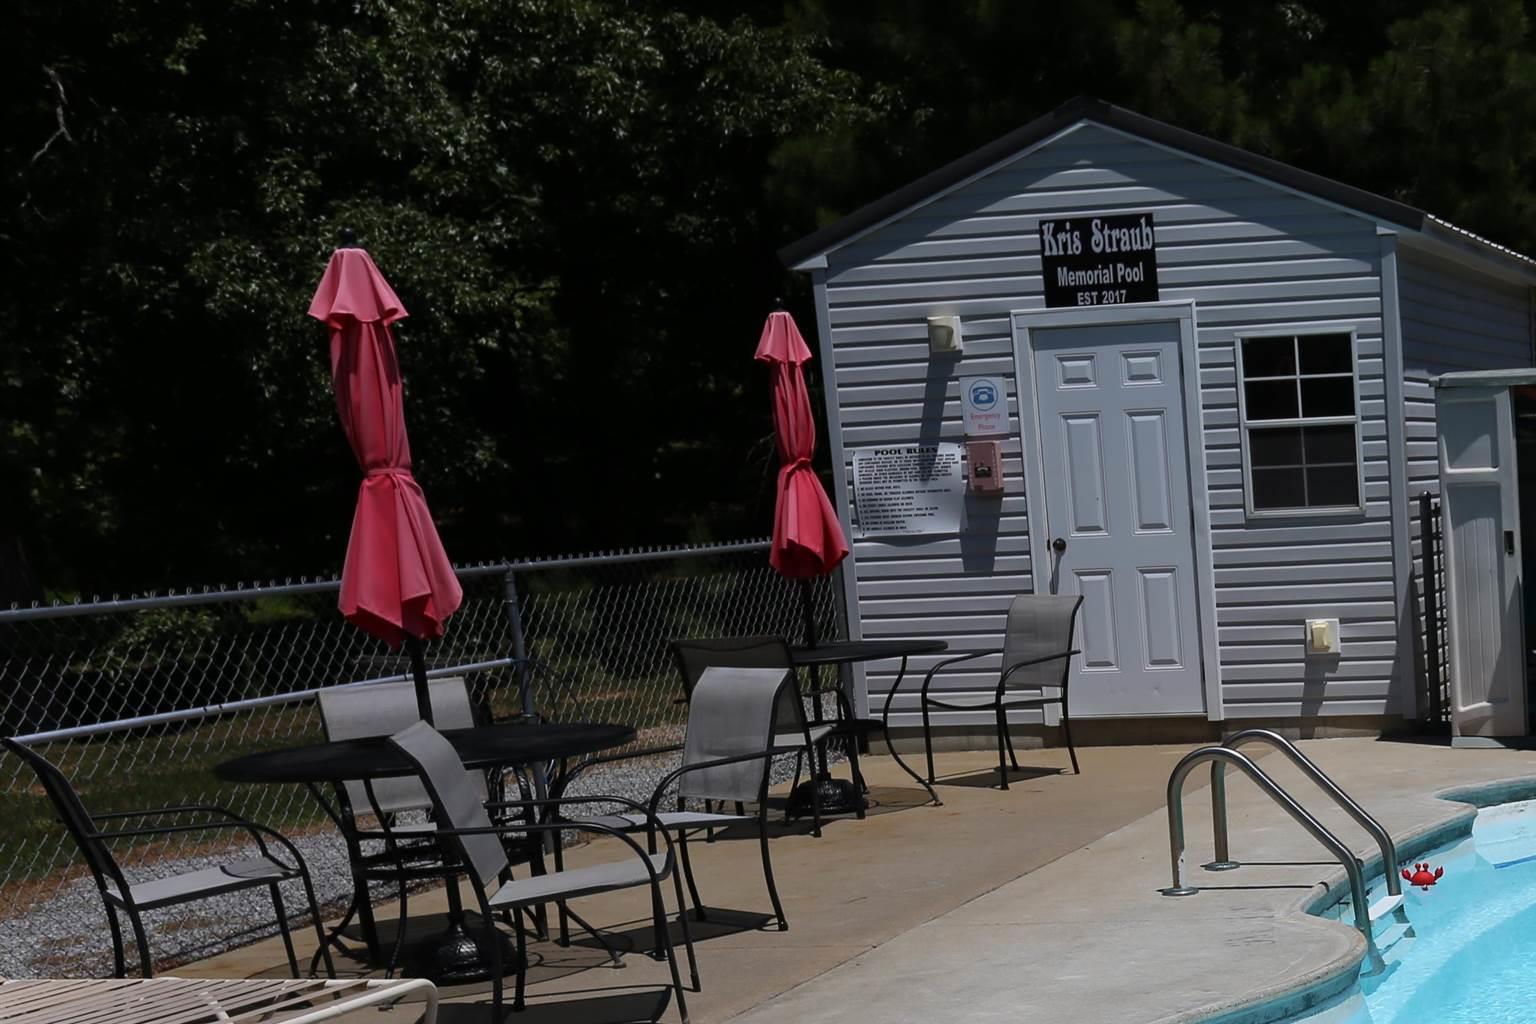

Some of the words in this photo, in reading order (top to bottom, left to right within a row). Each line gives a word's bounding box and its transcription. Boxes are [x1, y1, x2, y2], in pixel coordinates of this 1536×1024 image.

[1041, 221, 1082, 256] Kris
[1091, 216, 1153, 253] Straub
[1057, 263, 1114, 287] Memorial
[1117, 261, 1144, 283] Pool
[1077, 291, 1098, 305] EST
[1102, 289, 1127, 304] 2017
